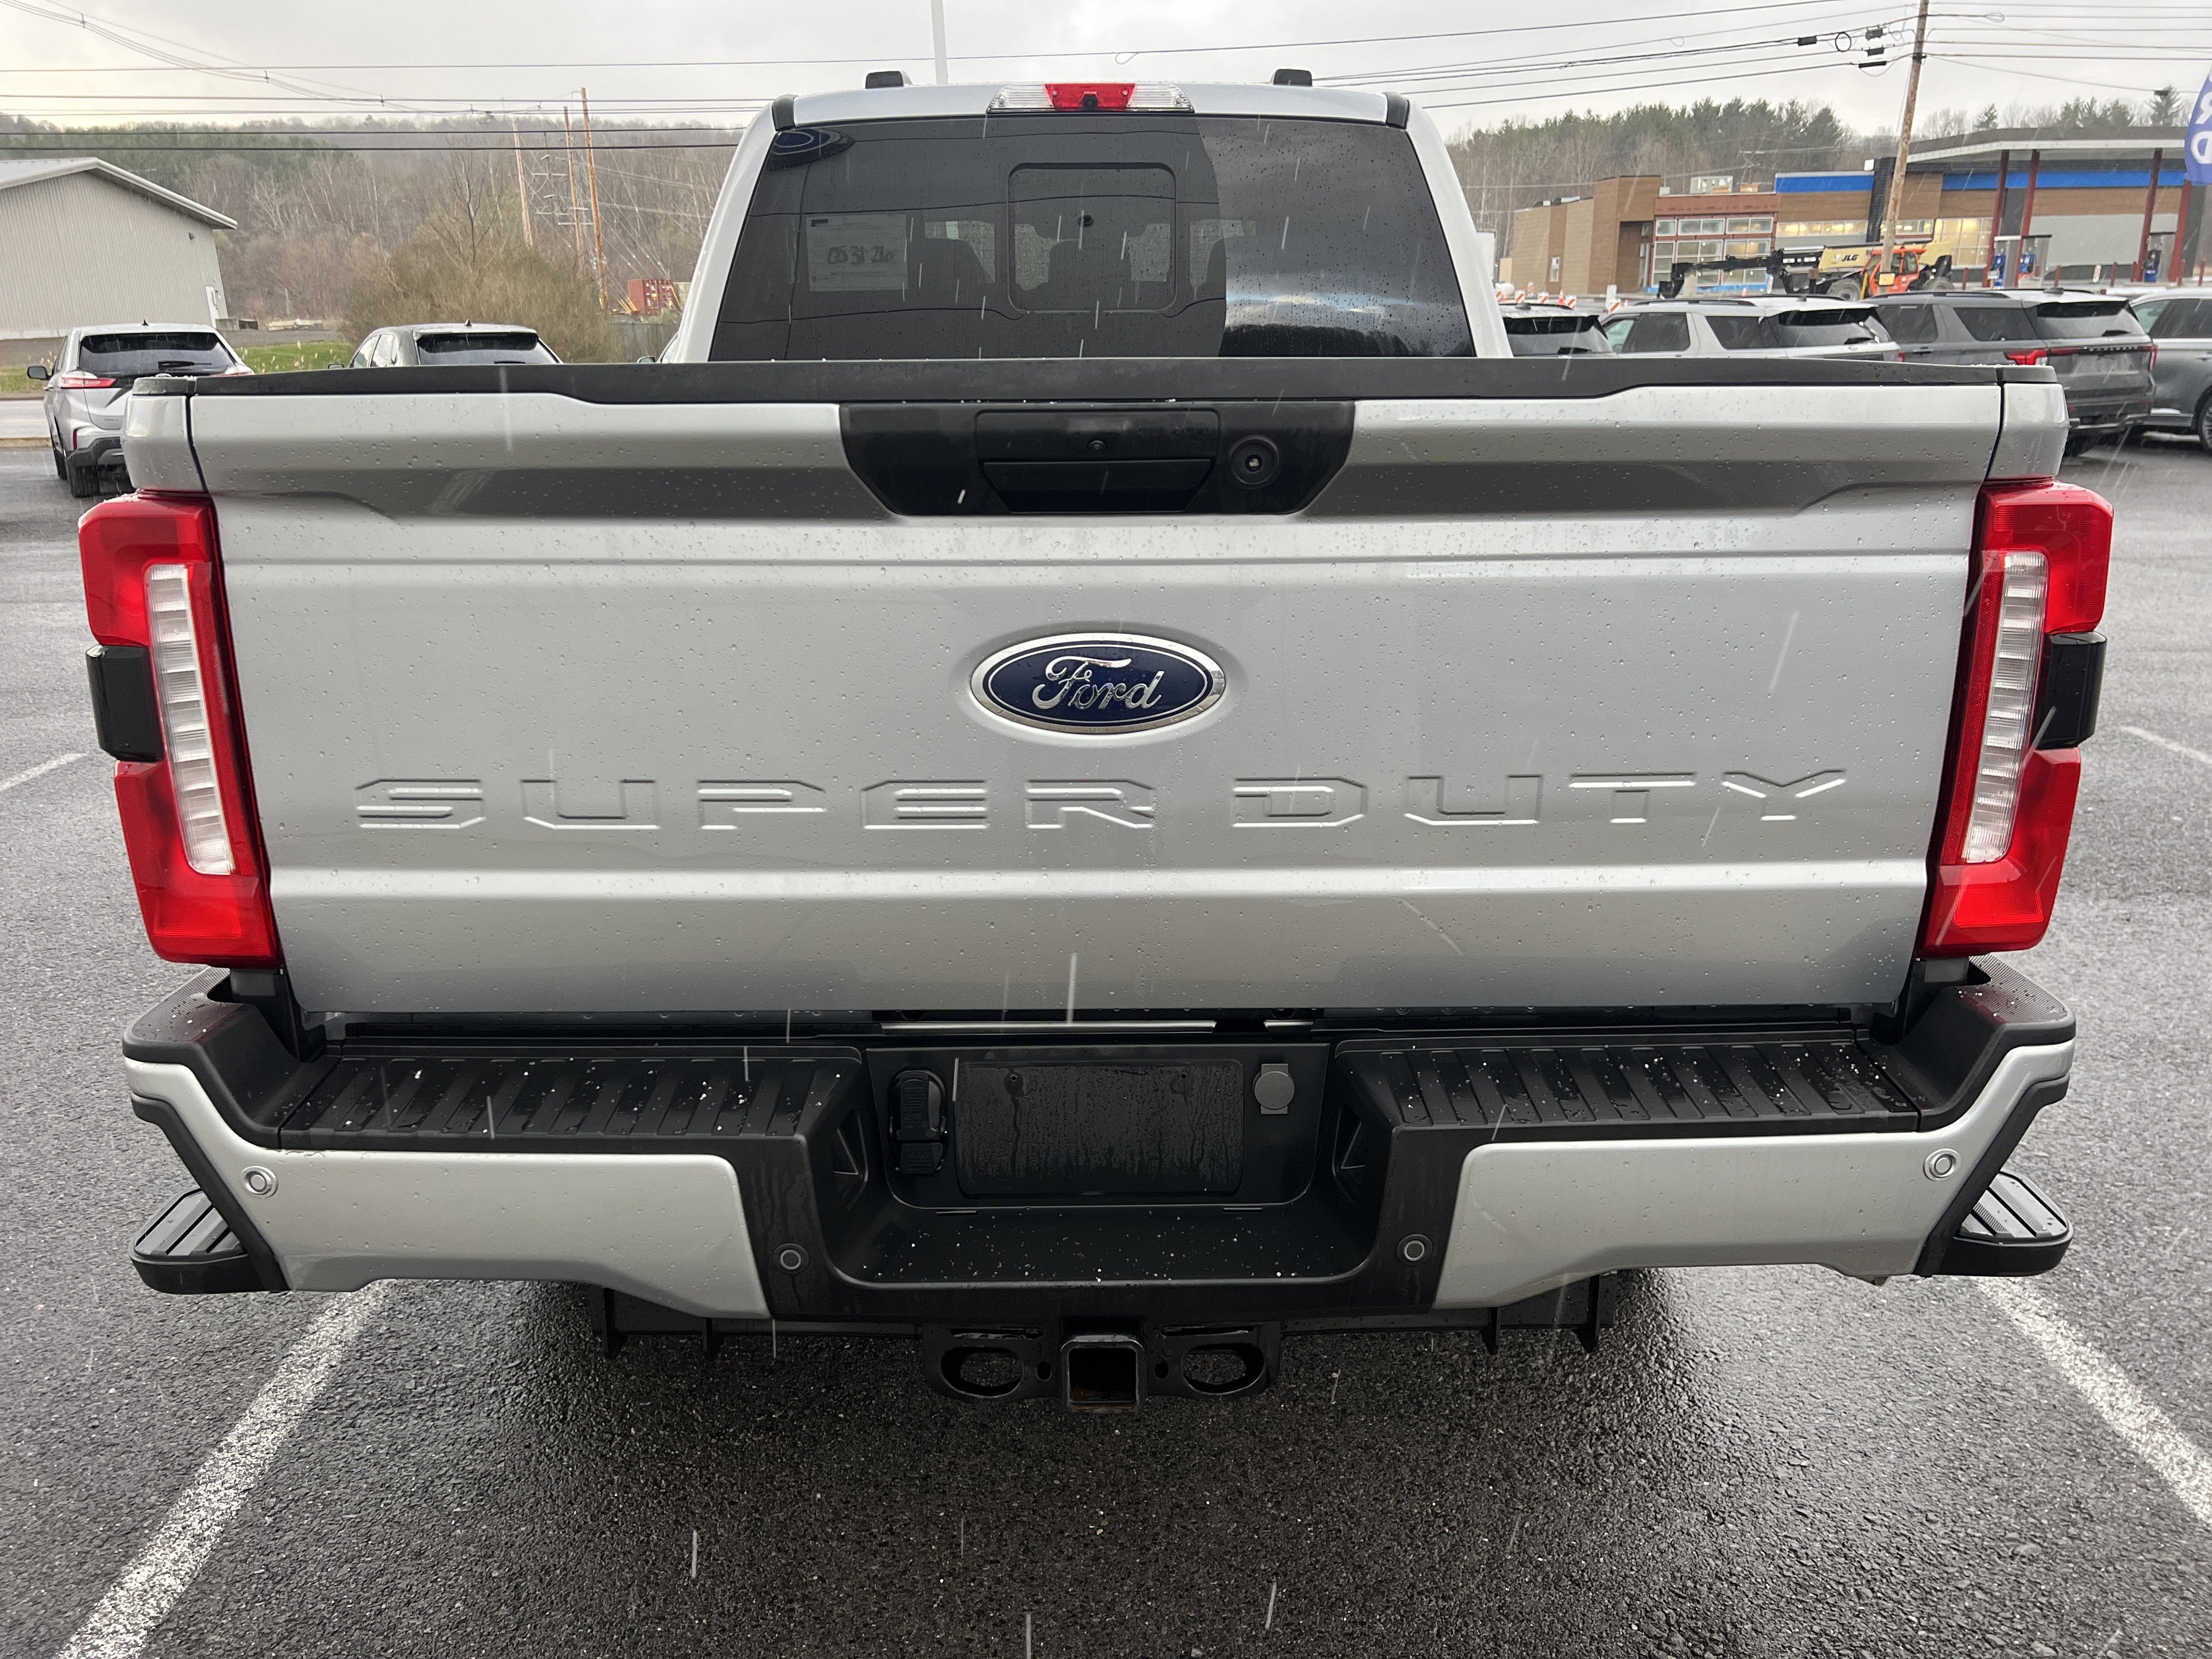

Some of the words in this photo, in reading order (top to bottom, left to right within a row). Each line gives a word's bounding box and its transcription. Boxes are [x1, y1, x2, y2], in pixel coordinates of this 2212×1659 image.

[1032, 655, 1164, 710] Ford
[356, 778, 1156, 831] SUPER
[1231, 768, 1847, 828] DUTY
